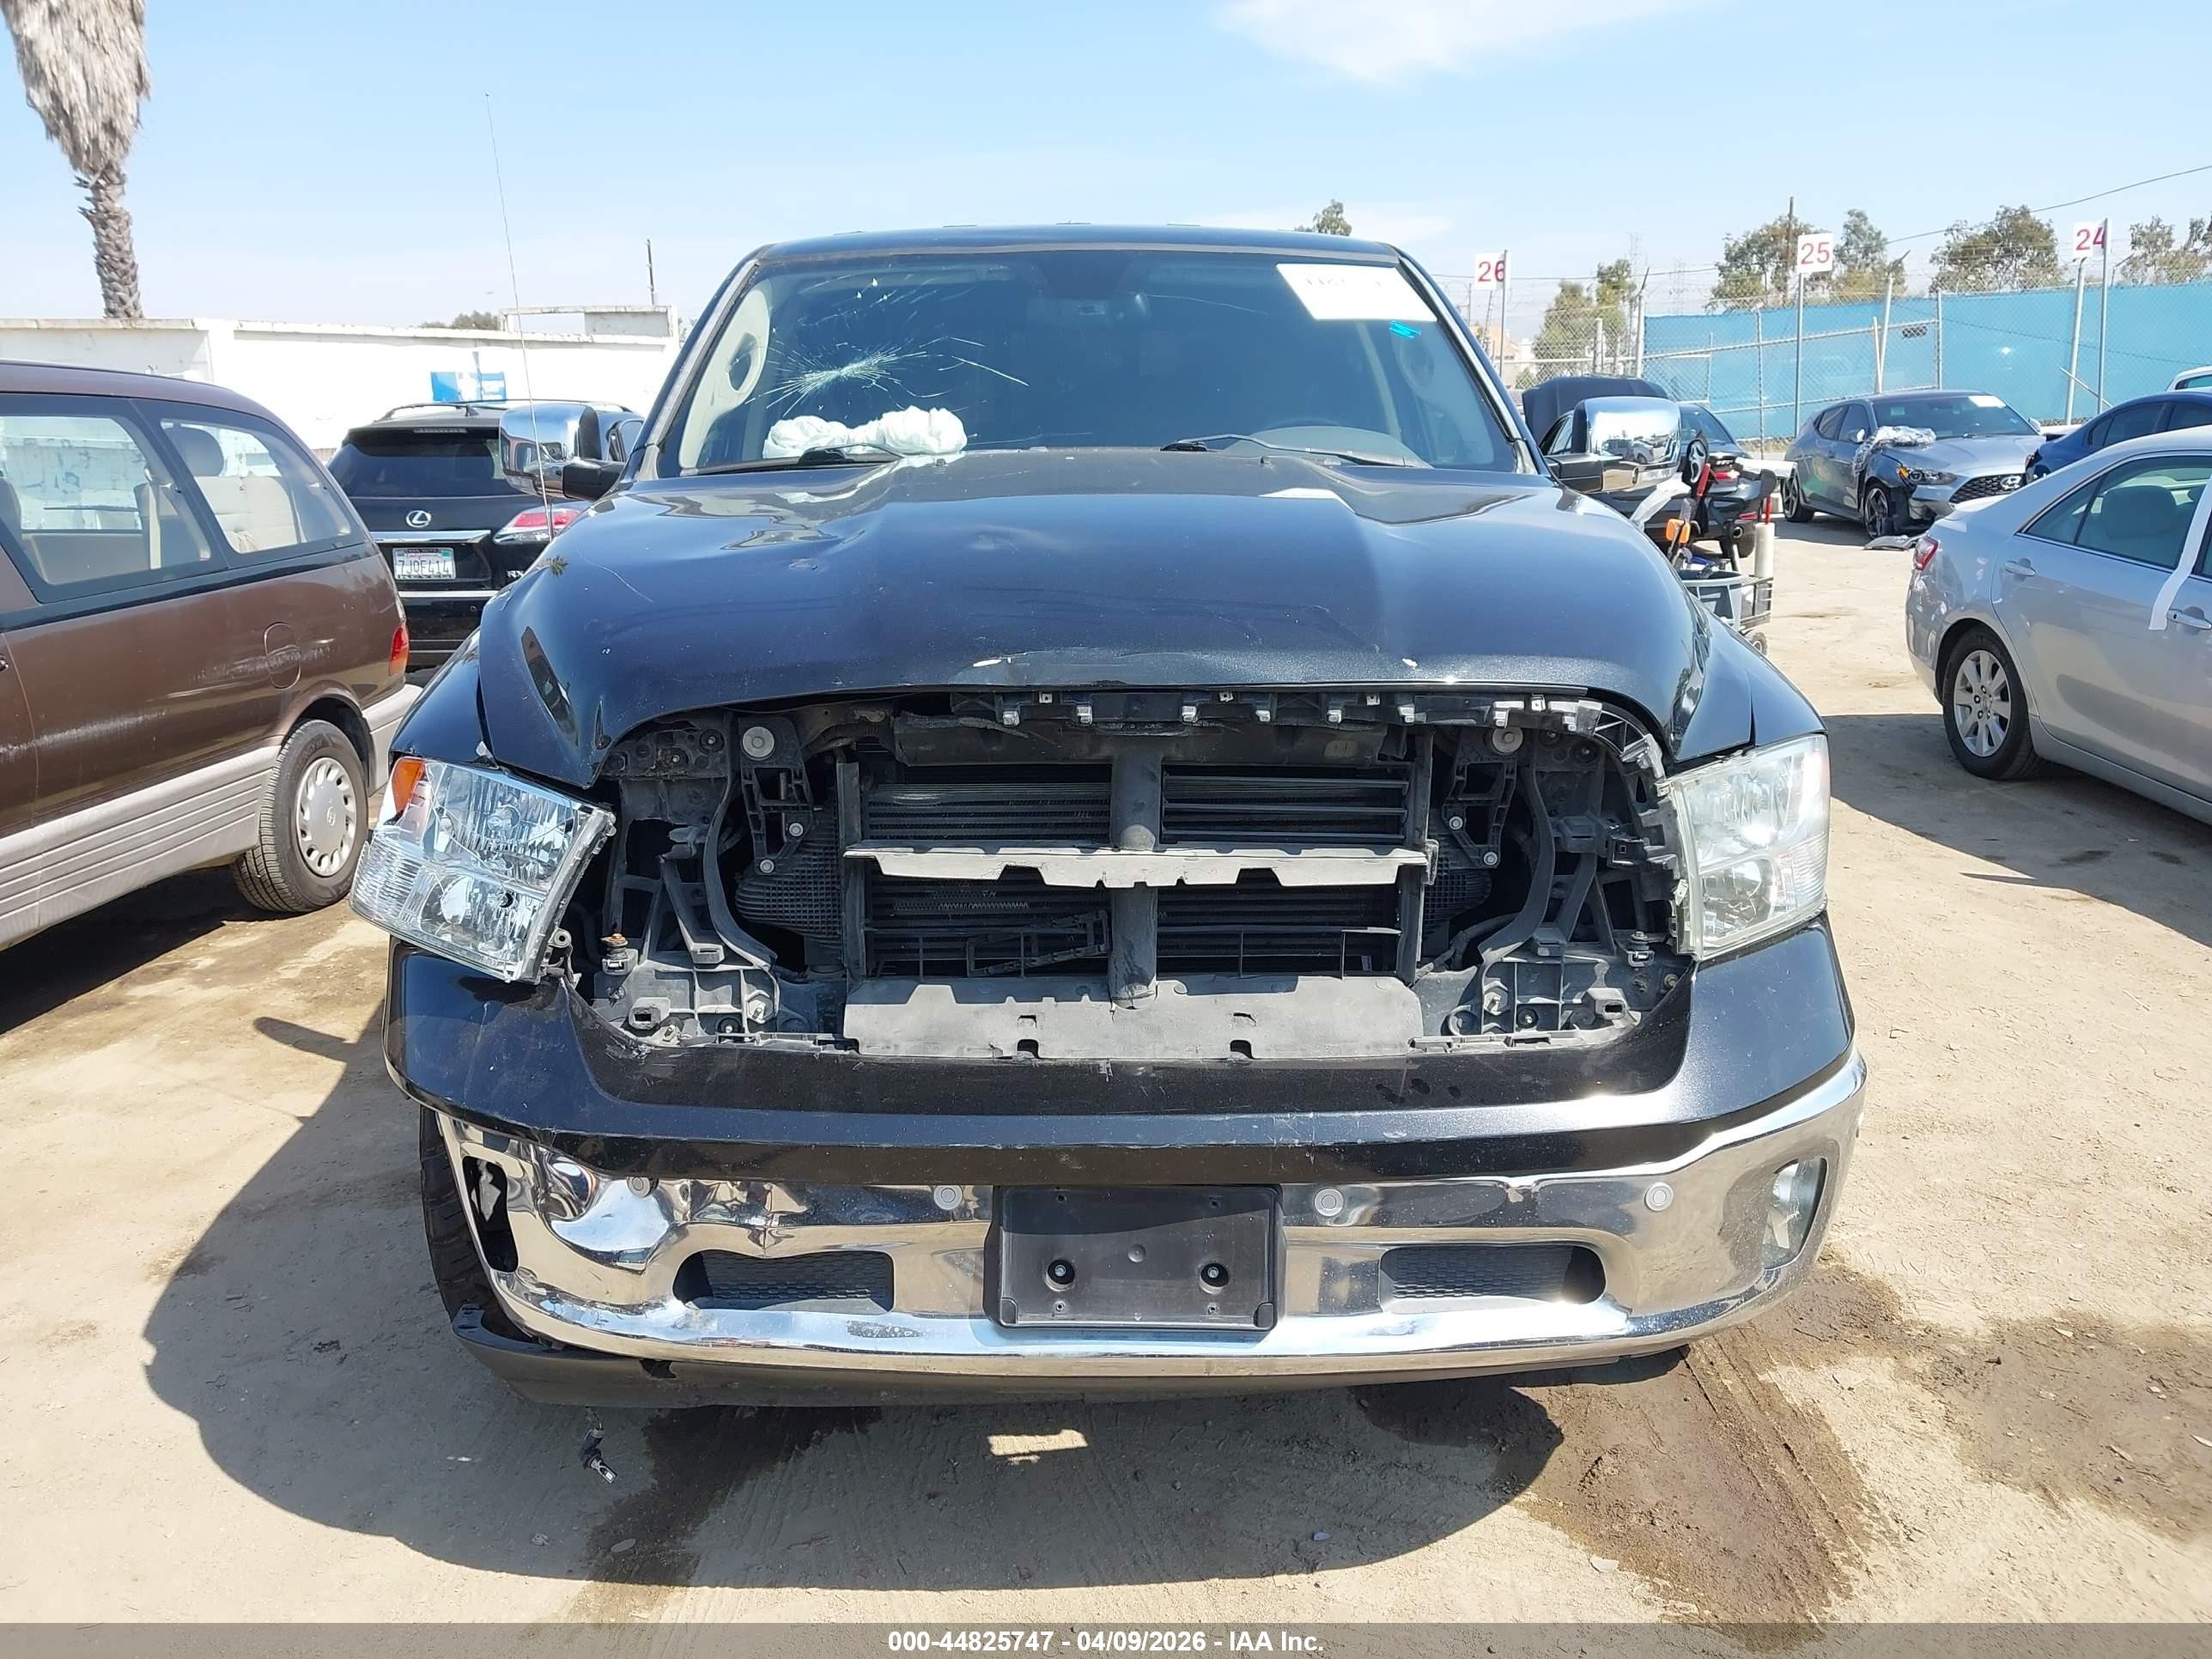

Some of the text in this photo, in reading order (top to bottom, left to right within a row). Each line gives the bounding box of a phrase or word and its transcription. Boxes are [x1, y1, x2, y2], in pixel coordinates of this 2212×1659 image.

[2075, 227, 2106, 251] 24
[1801, 241, 1830, 264] 25
[1477, 260, 1505, 283] 26
